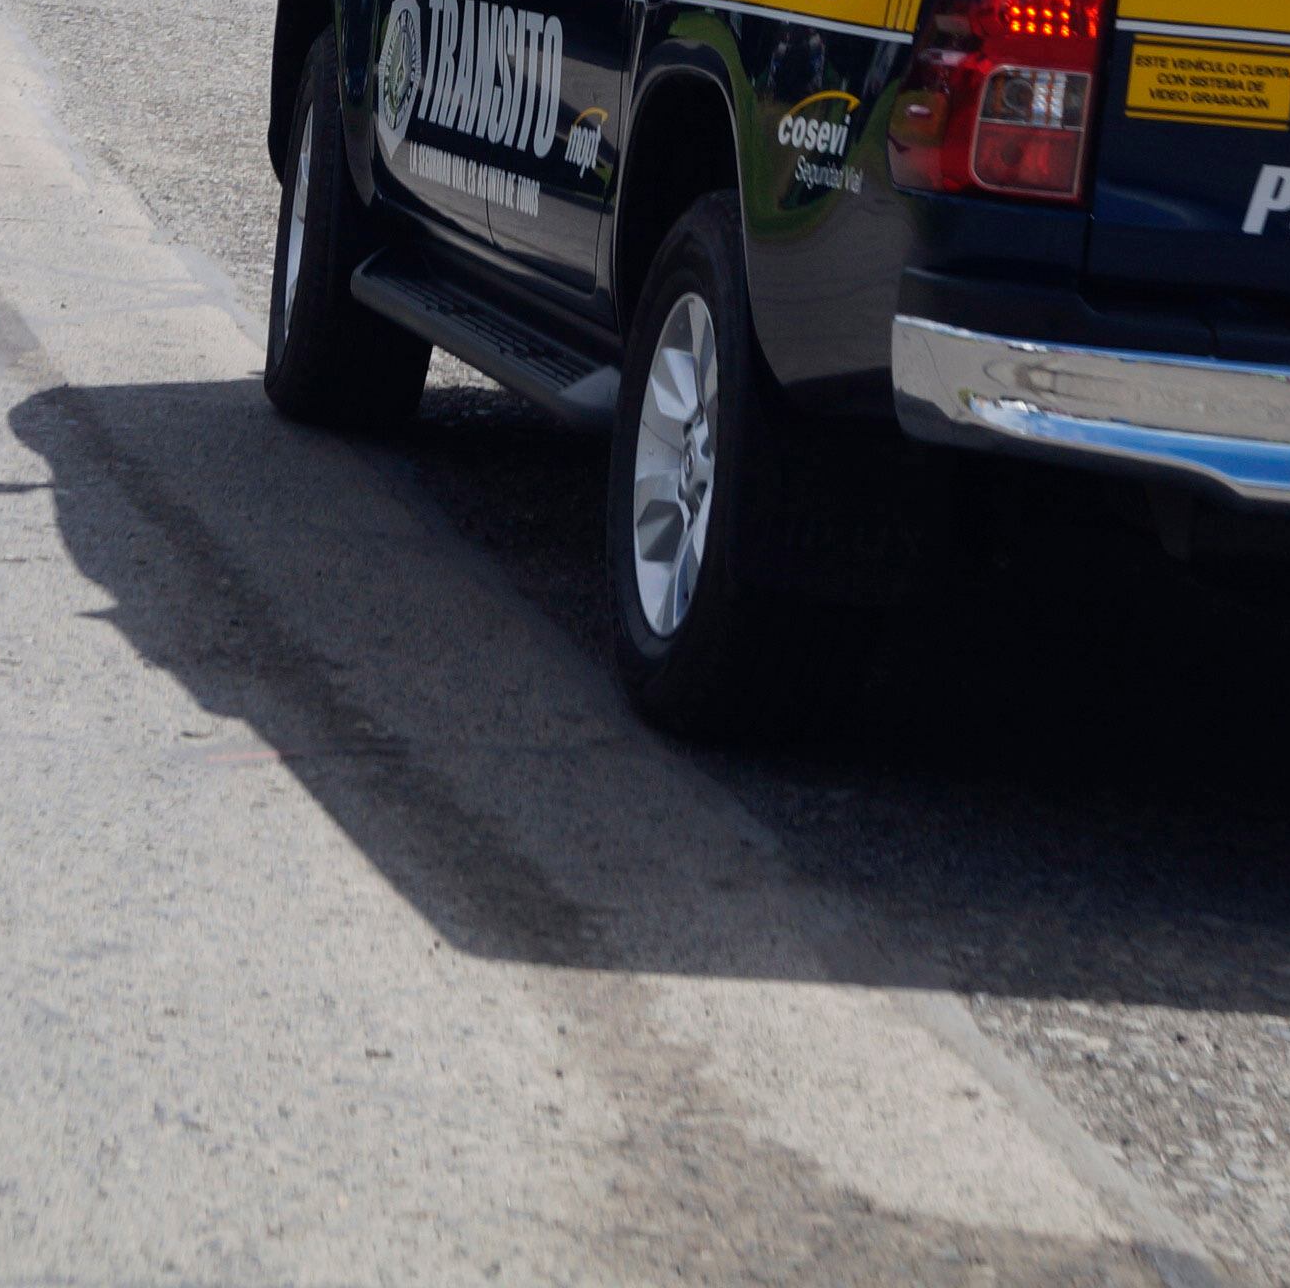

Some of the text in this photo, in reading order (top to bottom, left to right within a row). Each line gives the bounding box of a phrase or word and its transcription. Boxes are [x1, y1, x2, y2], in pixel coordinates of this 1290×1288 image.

[1135, 55, 1169, 68] ESTE
[1239, 63, 1290, 78] CUENTA
[1157, 73, 1265, 93] CON SISTEMA DE
[1149, 87, 1269, 109] VIDEO GRABACIÓN
[778, 113, 851, 157] cosevi
[564, 123, 602, 179] mopt
